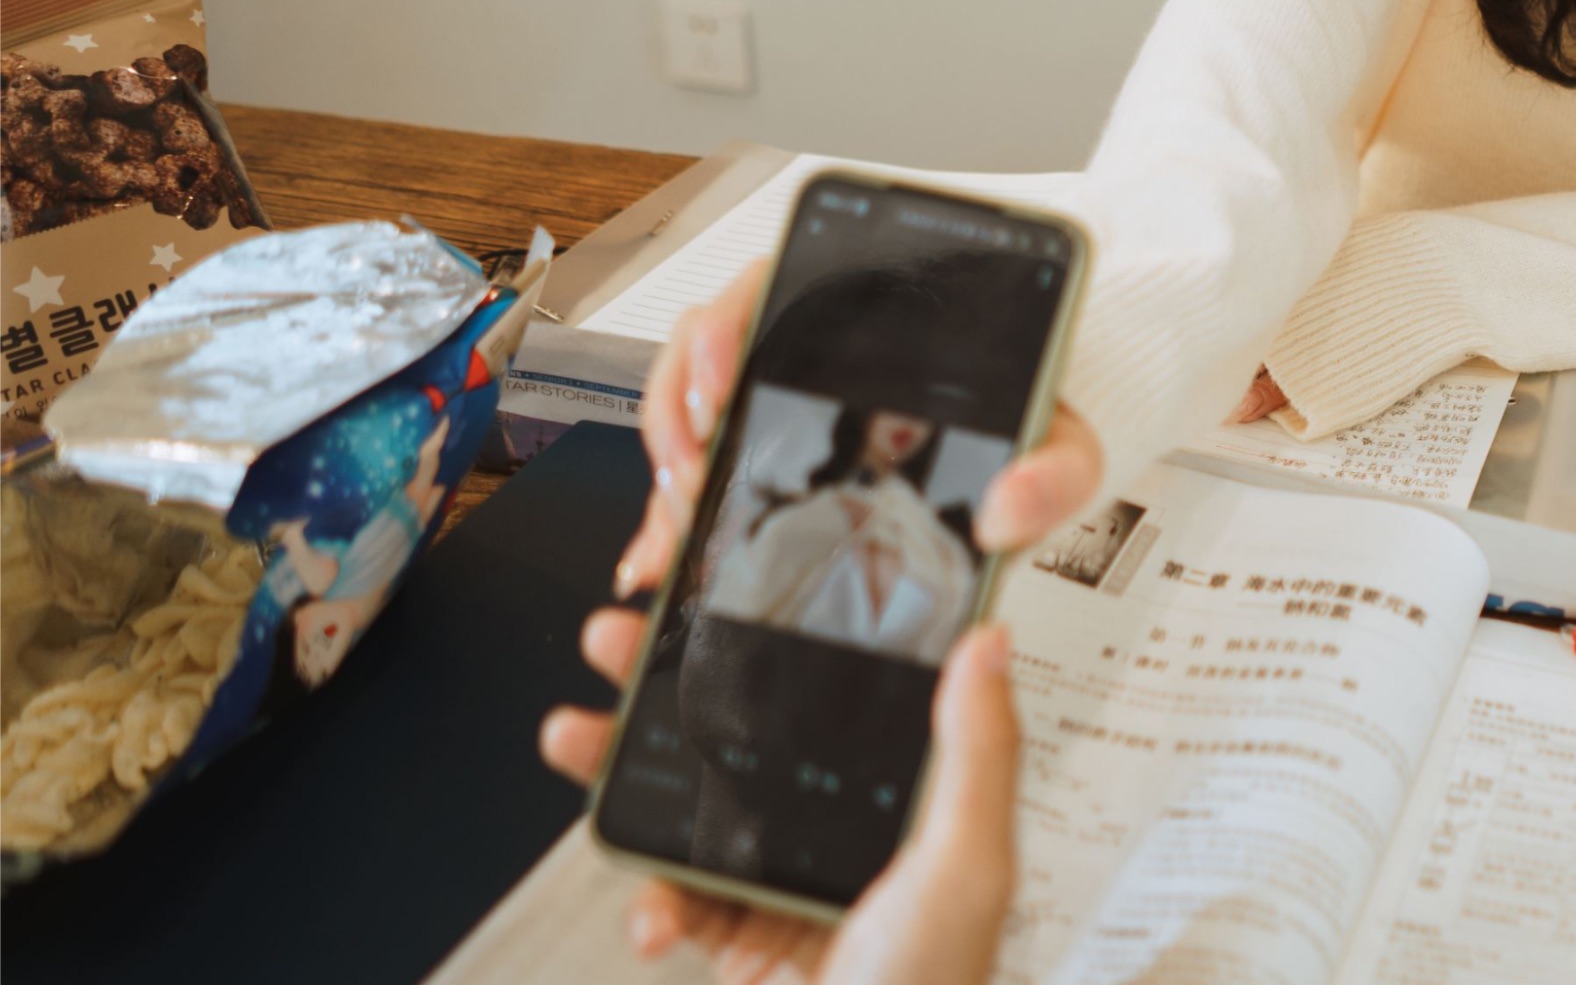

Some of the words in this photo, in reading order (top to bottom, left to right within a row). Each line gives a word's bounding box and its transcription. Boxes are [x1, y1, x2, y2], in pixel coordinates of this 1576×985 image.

[0, 276, 175, 374] 별클래
[1, 379, 43, 402] TAR
[53, 362, 97, 385] CLA
[540, 385, 616, 409] STORIES
